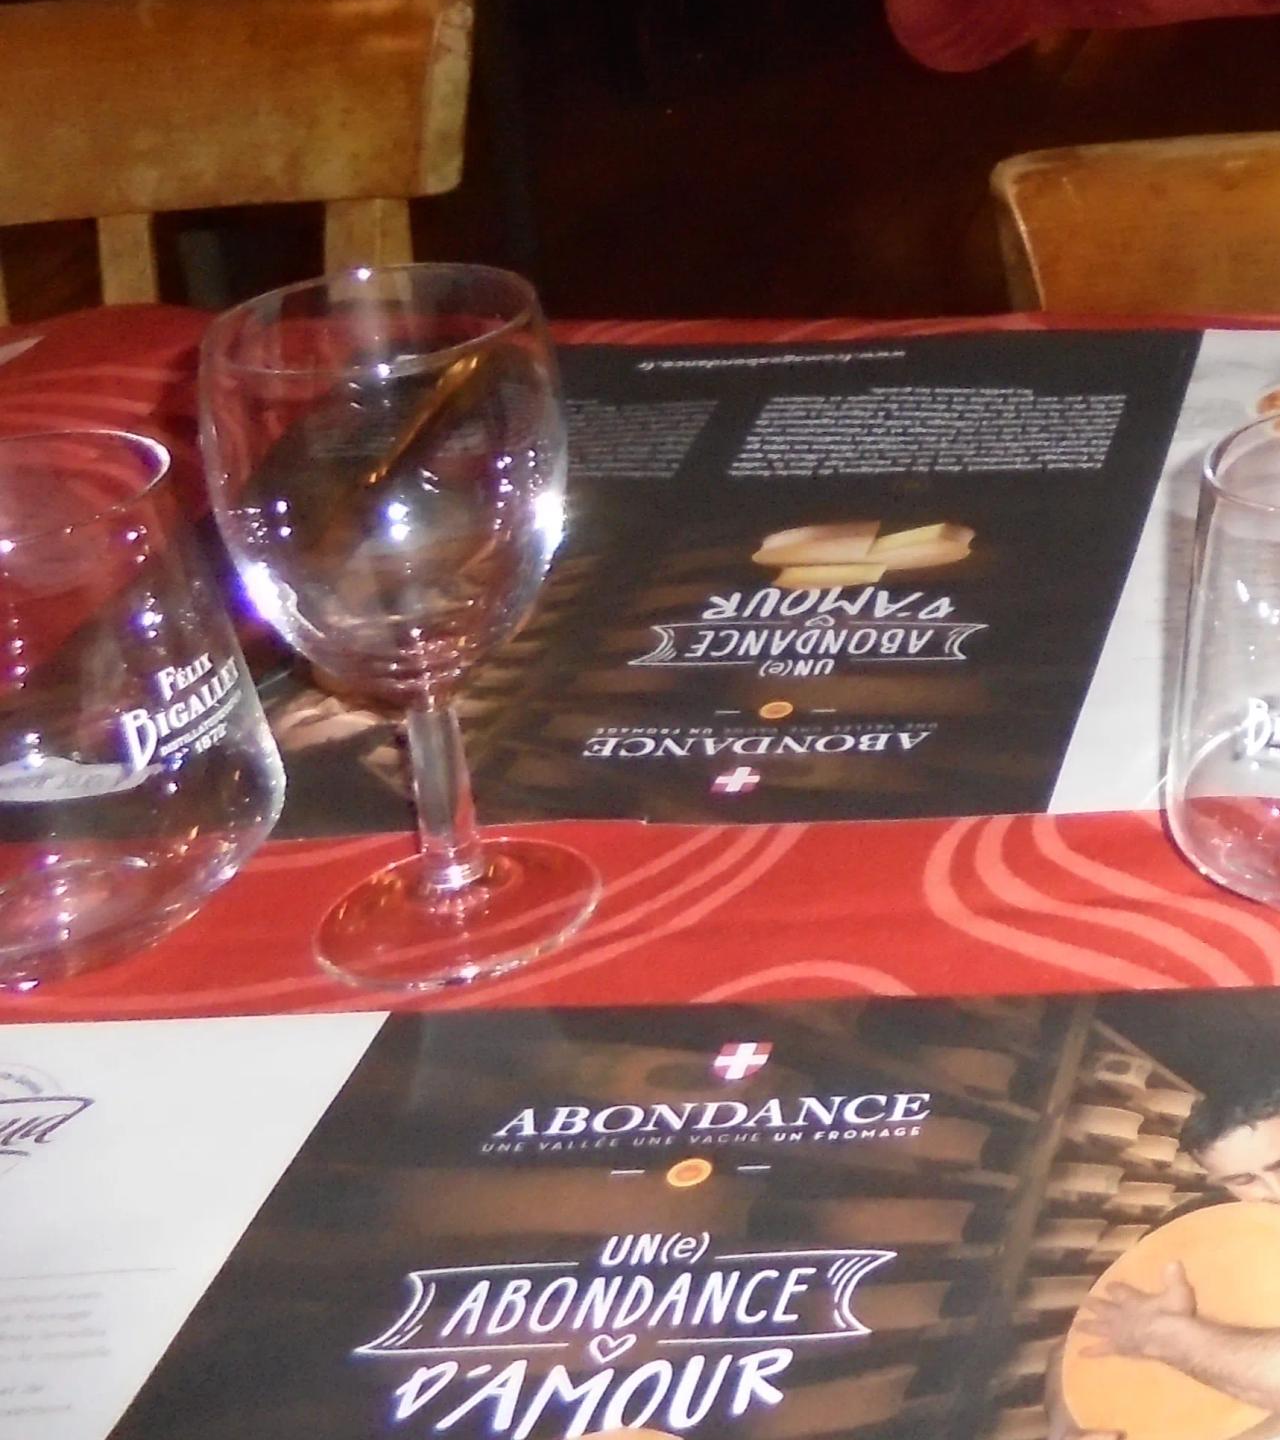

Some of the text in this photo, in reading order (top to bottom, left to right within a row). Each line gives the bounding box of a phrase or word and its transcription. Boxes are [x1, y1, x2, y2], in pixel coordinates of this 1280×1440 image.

[702, 585, 954, 620] D'AMOUR
[685, 628, 934, 658] ABONDANCE
[759, 659, 834, 677] UN(e)
[583, 731, 932, 758] ABONDANCE
[494, 1093, 932, 1139] ABONDANCE
[482, 1127, 921, 1153] UNE VALLÉE UNE VACHE UN FROMAGE
[602, 1232, 710, 1266] UN(e)
[441, 1268, 817, 1338] ABONDANCE
[395, 1348, 793, 1440] D'AMOUR
